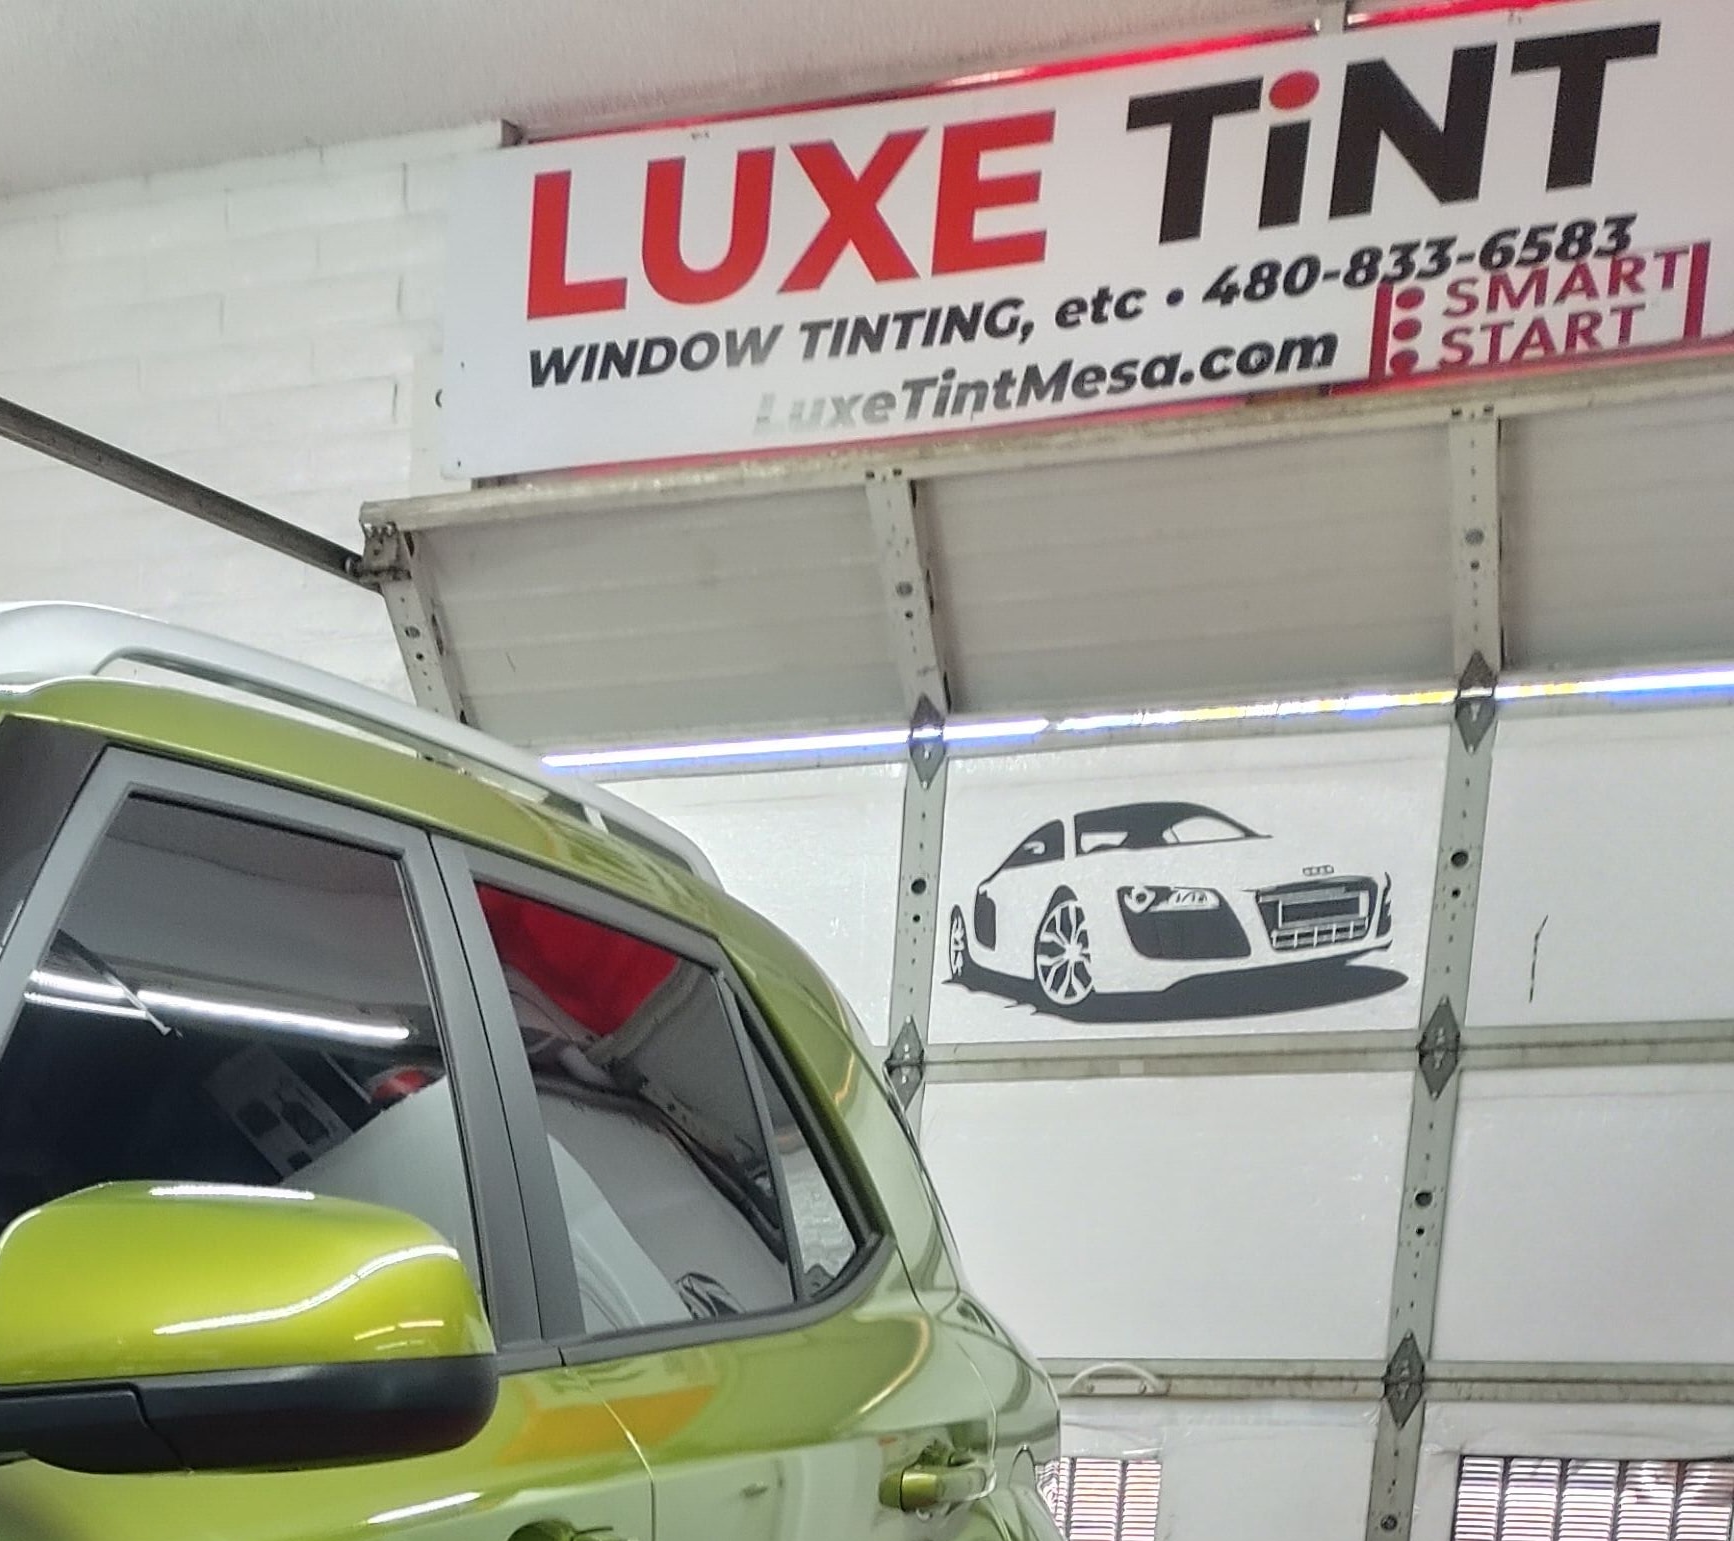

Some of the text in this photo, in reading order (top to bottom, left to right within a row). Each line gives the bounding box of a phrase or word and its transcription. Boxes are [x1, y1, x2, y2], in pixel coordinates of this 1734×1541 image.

[527, 109, 1055, 320] LUXE
[529, 212, 1638, 389] WINDOW TINTING, etc 480-833-6583
[1440, 303, 1646, 368] START
[1442, 246, 1690, 319] SMART
[752, 329, 1339, 436] LuxeTintMesa.com
